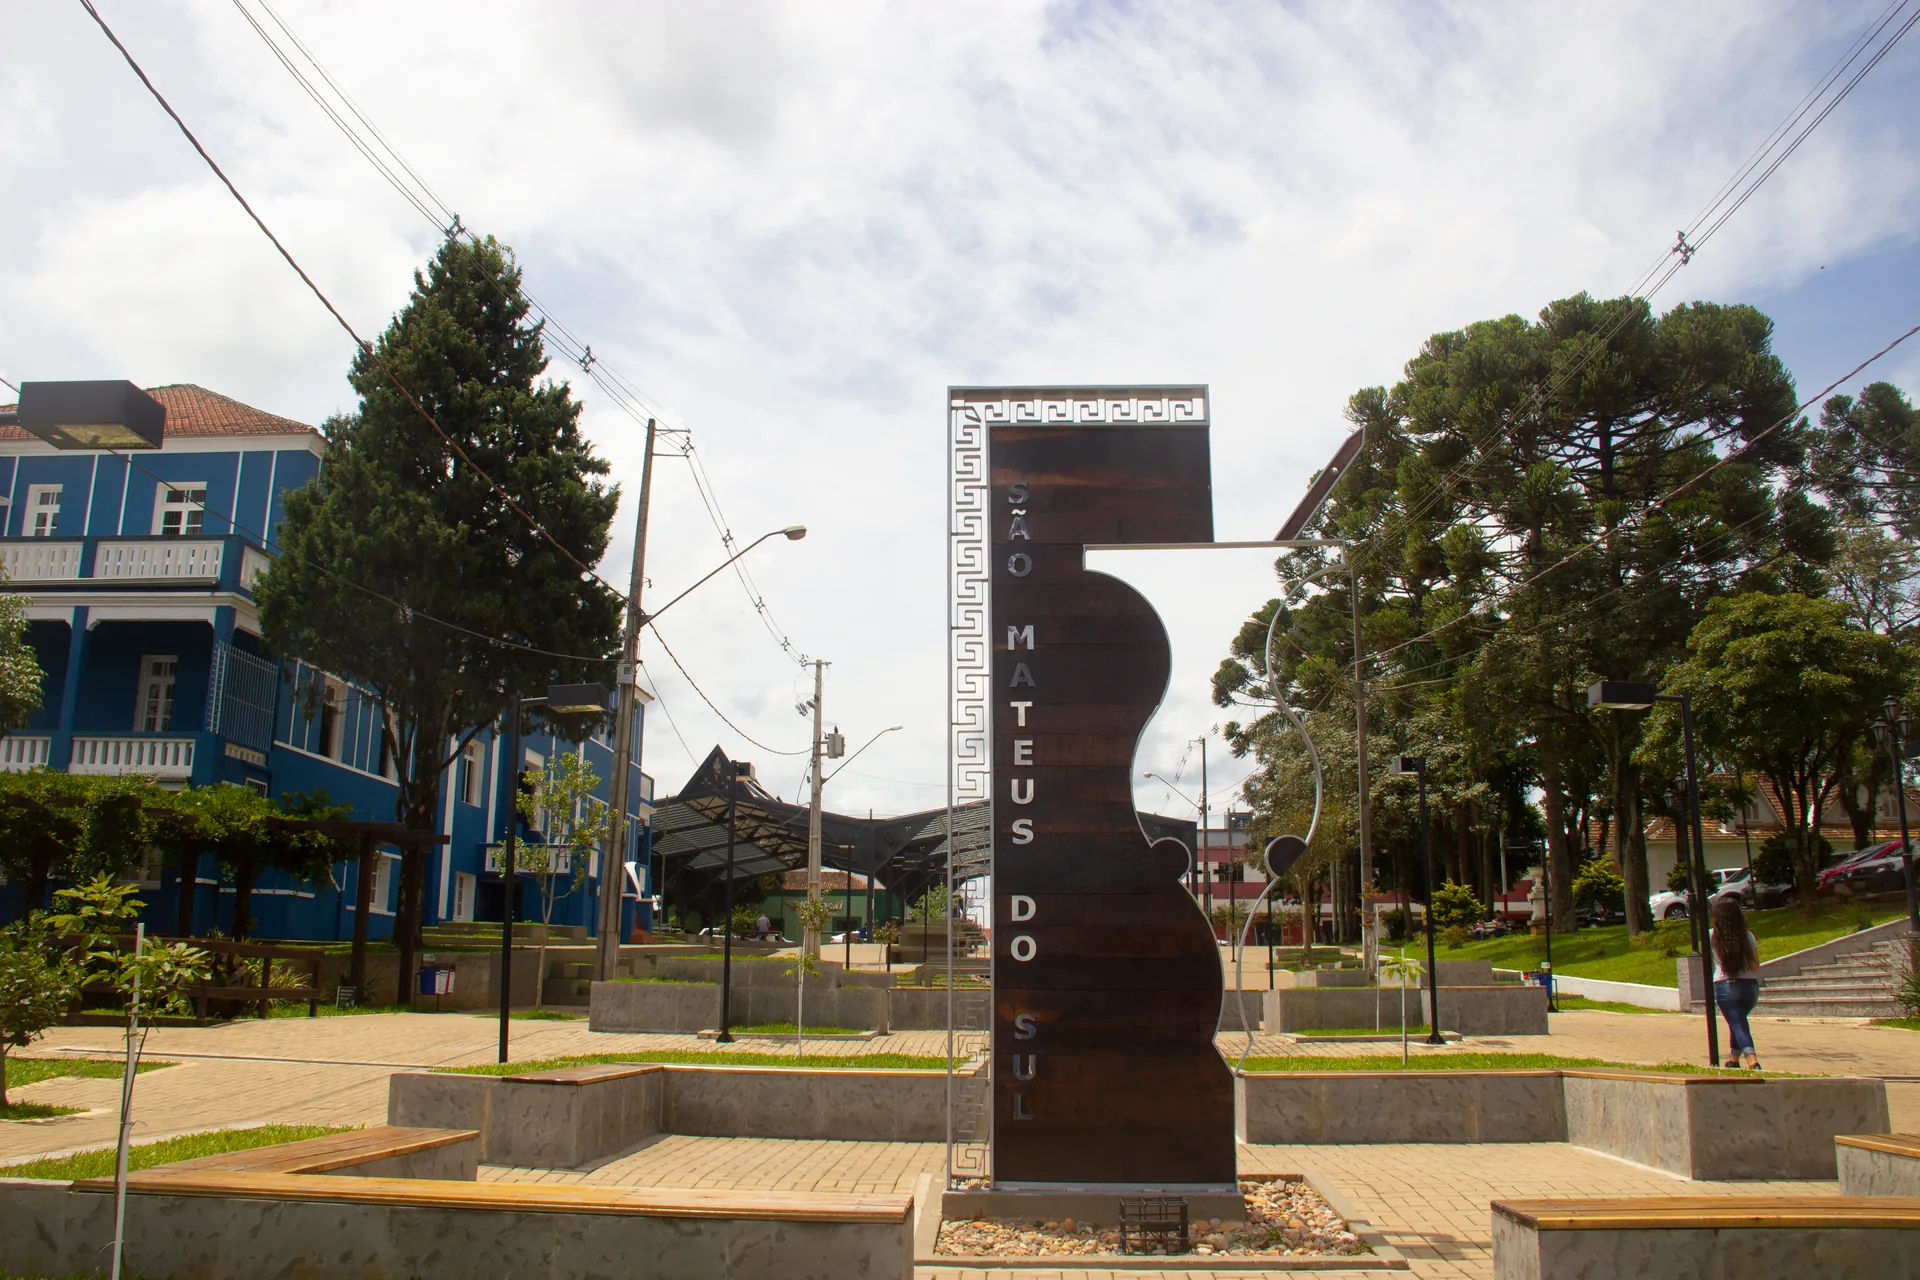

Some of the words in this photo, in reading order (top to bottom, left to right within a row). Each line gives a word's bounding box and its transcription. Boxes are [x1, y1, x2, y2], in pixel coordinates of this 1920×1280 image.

[1007, 480, 1033, 578] SÃO
[1007, 624, 1036, 845] MATEUS
[1010, 895, 1037, 962] DO
[1011, 1013, 1037, 1121] SUL
